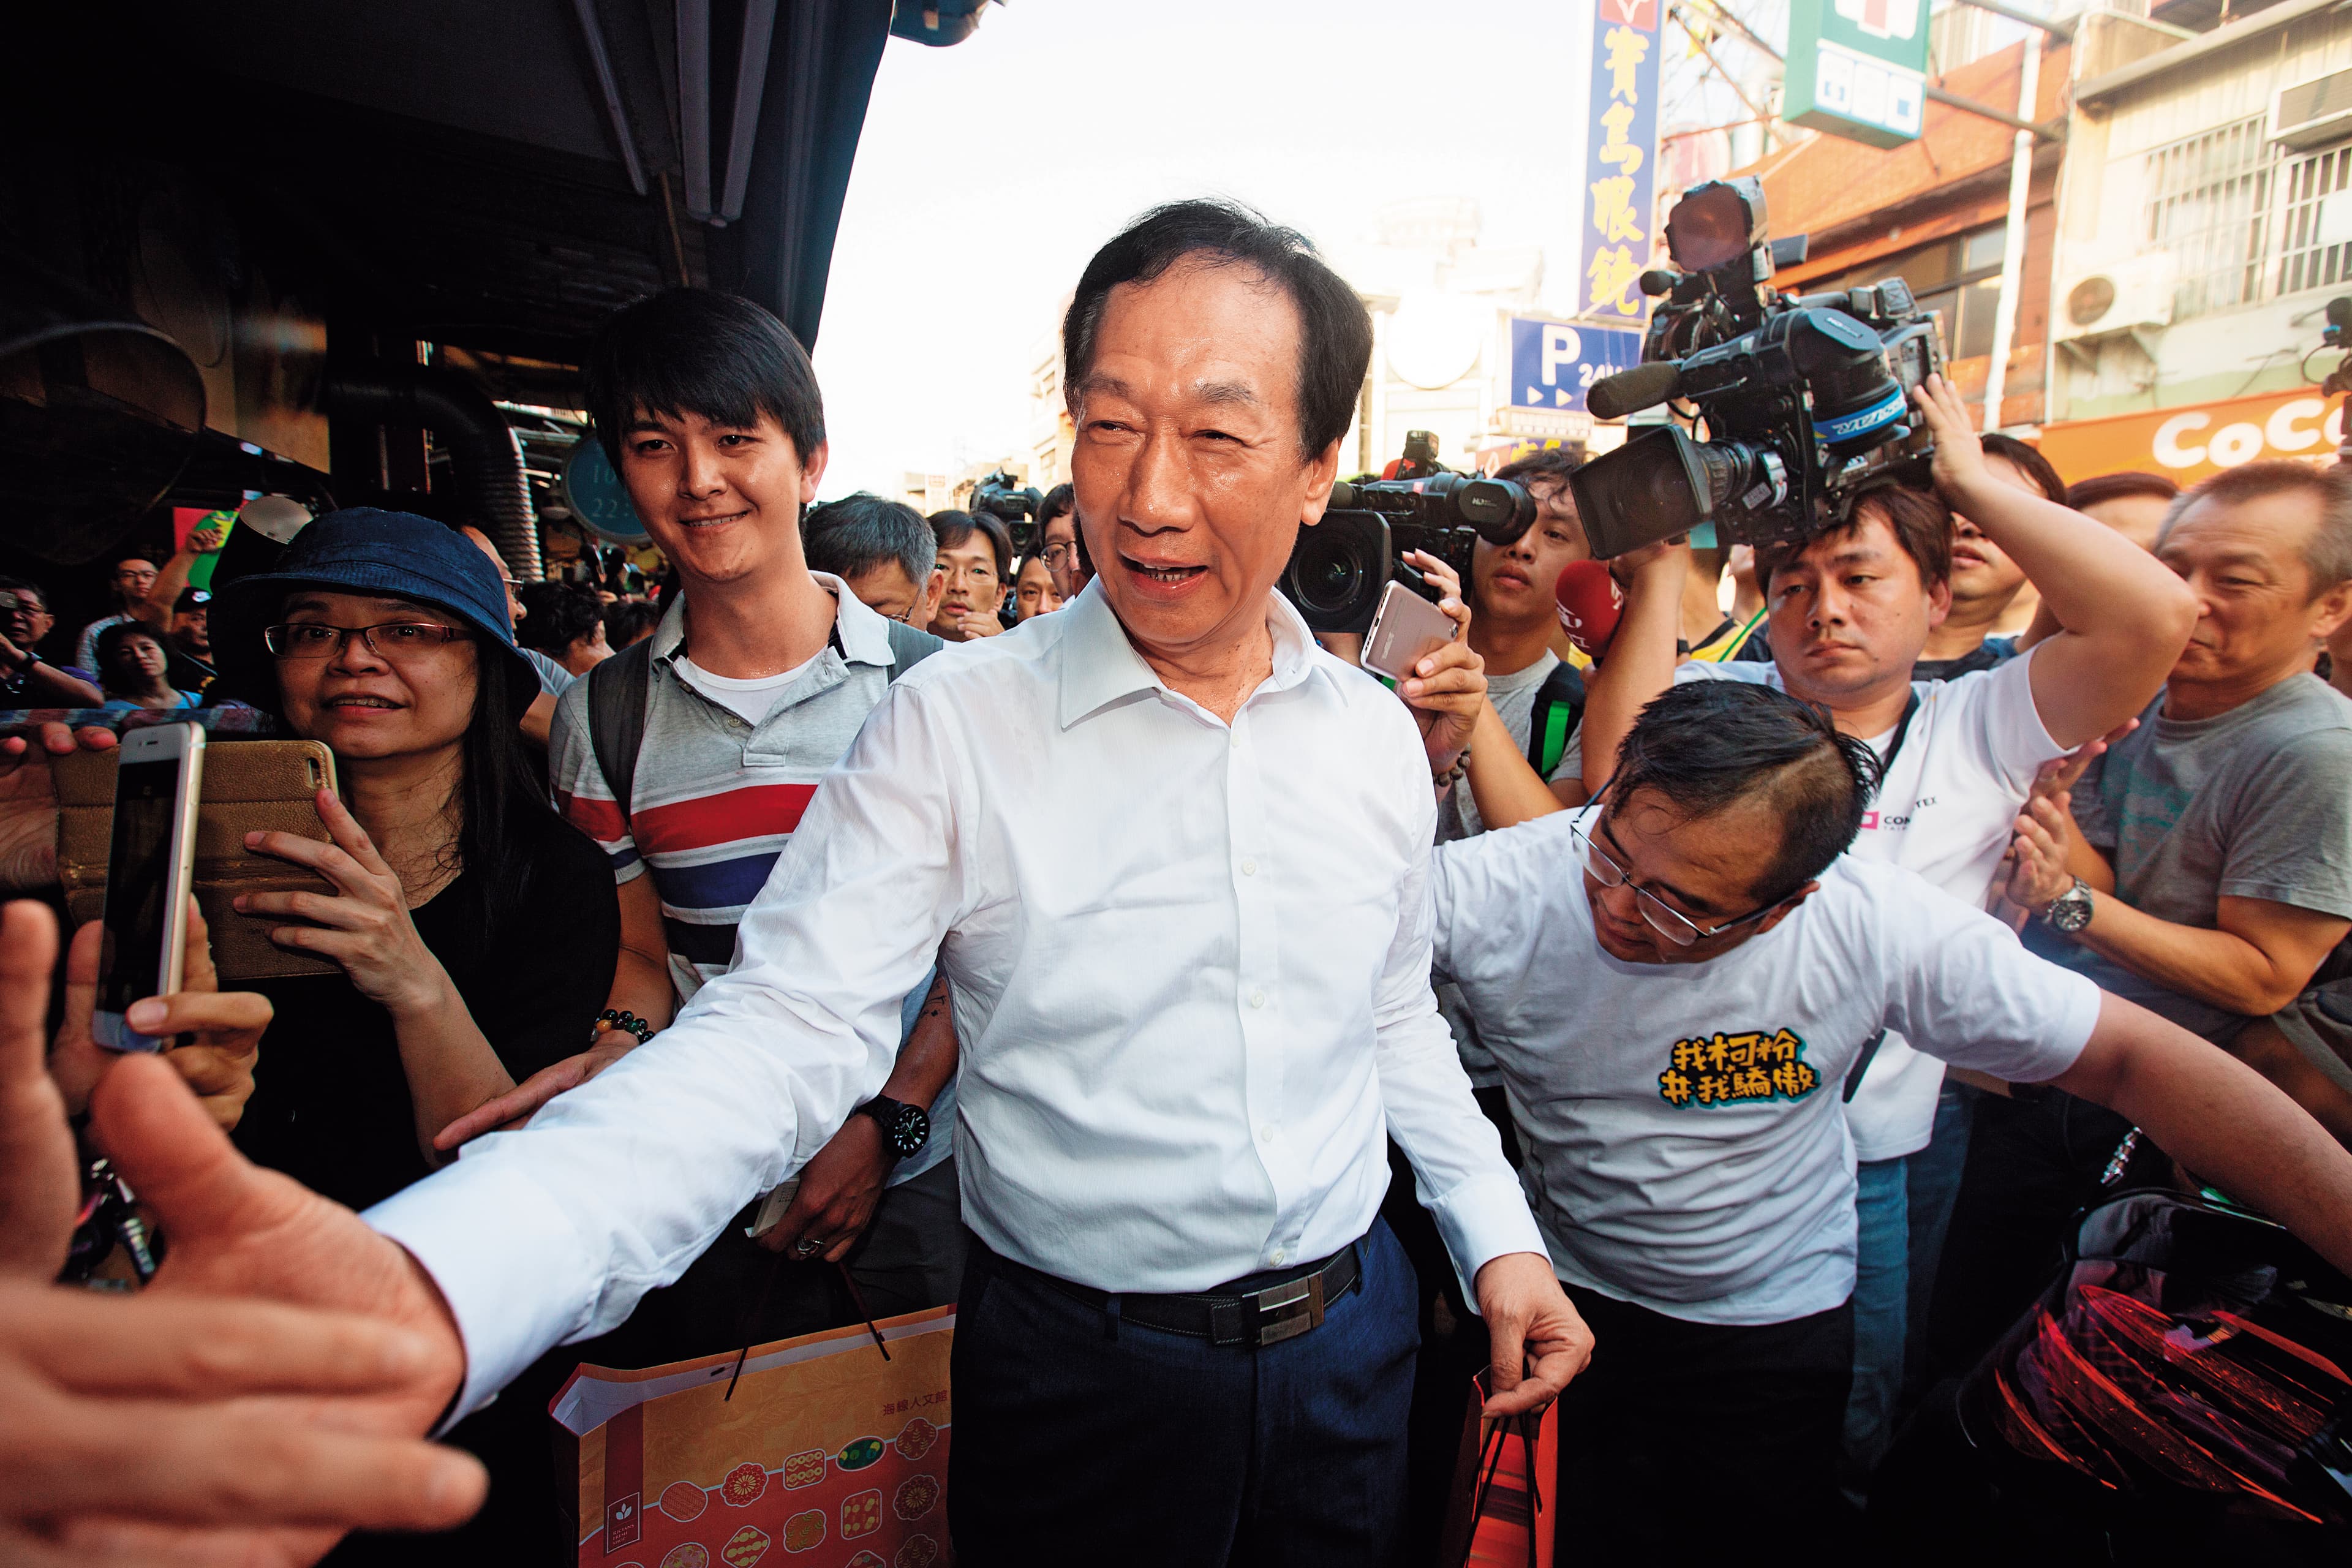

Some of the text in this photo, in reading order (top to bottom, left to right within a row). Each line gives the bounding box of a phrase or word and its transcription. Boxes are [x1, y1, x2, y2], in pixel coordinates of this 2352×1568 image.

[1586, 24, 1649, 316] 寶島眼鏡
[1541, 324, 1581, 386] P
[1674, 1030, 1800, 1072] 我柯粉
